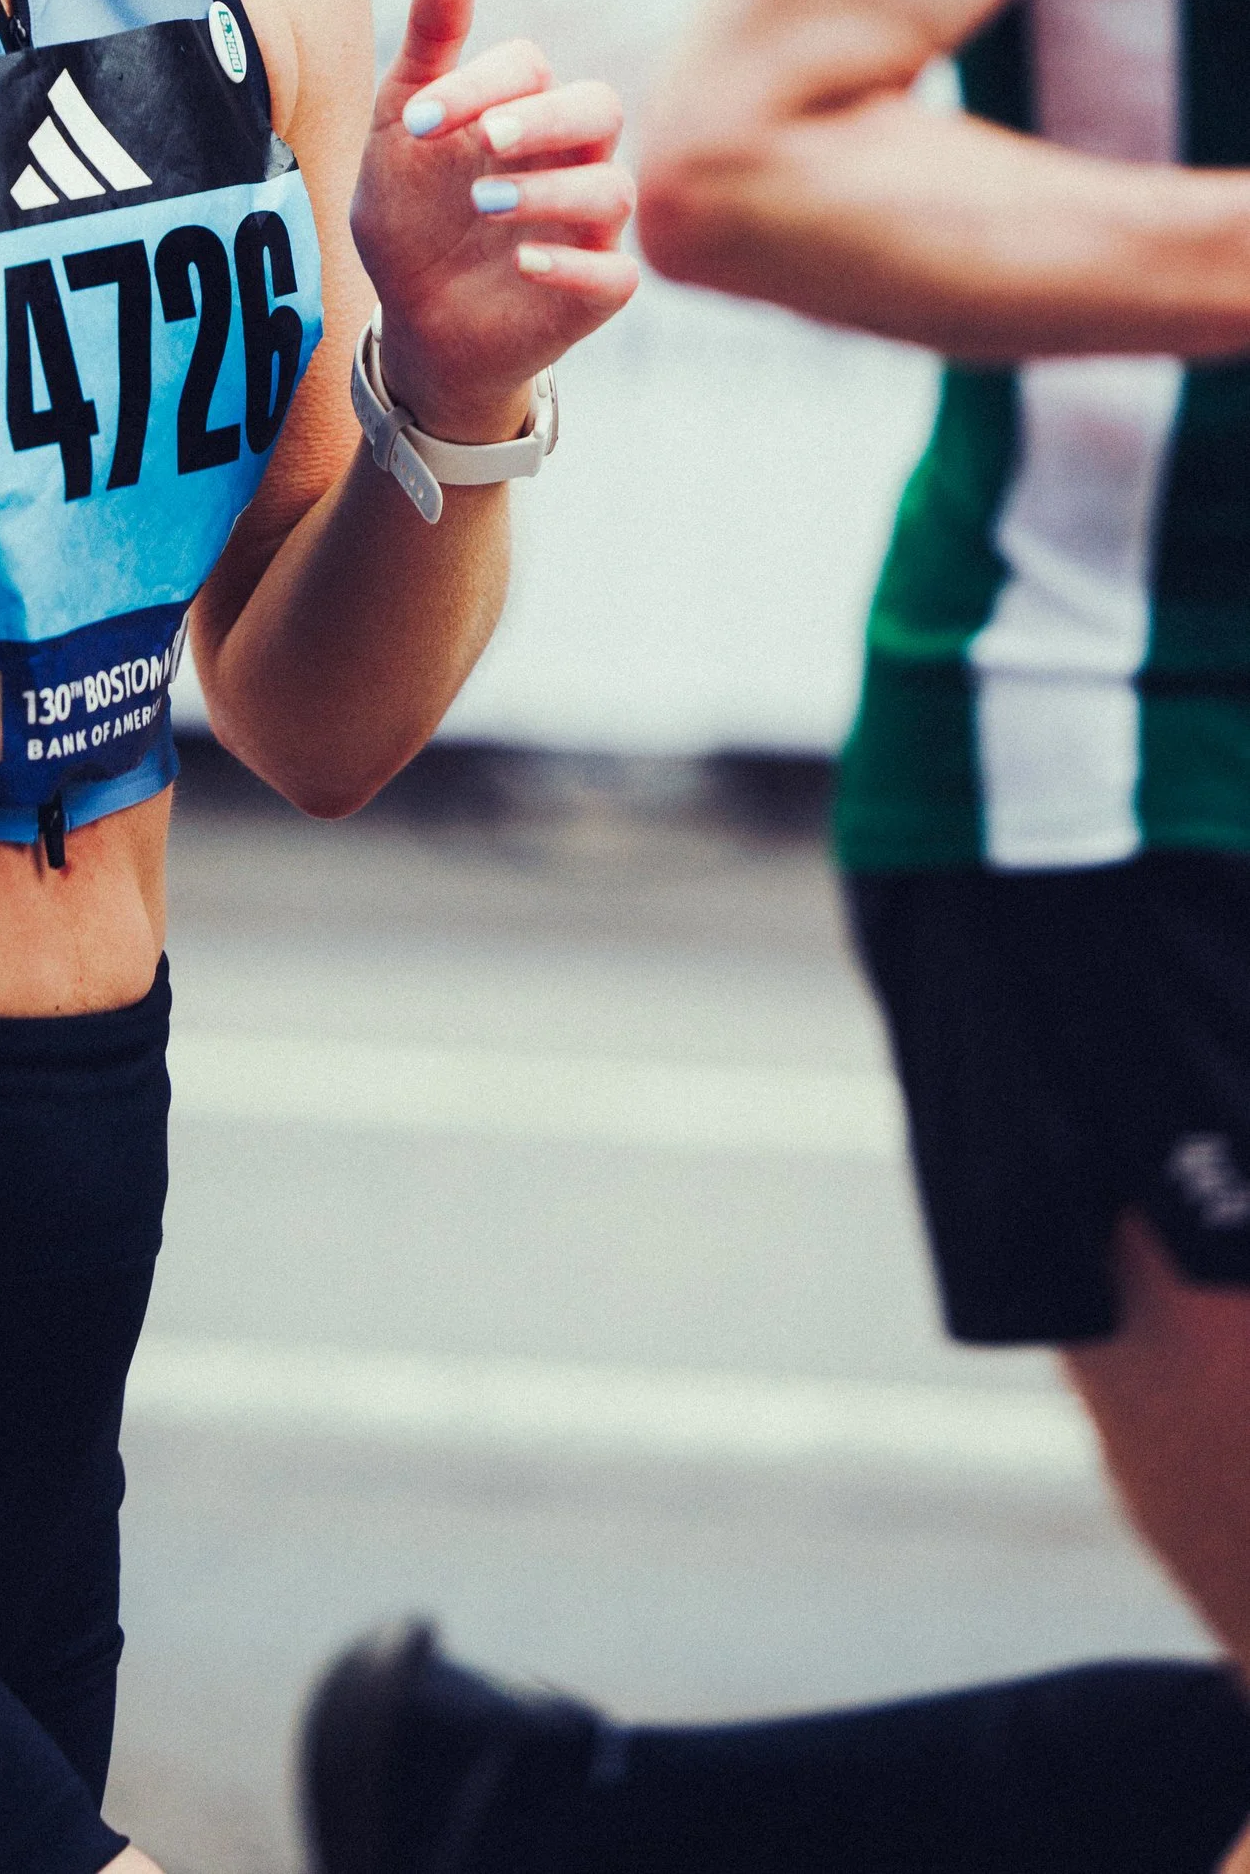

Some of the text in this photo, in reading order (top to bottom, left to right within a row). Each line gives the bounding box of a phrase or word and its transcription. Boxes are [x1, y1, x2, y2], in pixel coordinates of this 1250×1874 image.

[84, 655, 163, 713] BOSTON
[27, 728, 88, 760] BANK
[91, 721, 111, 747] OF
